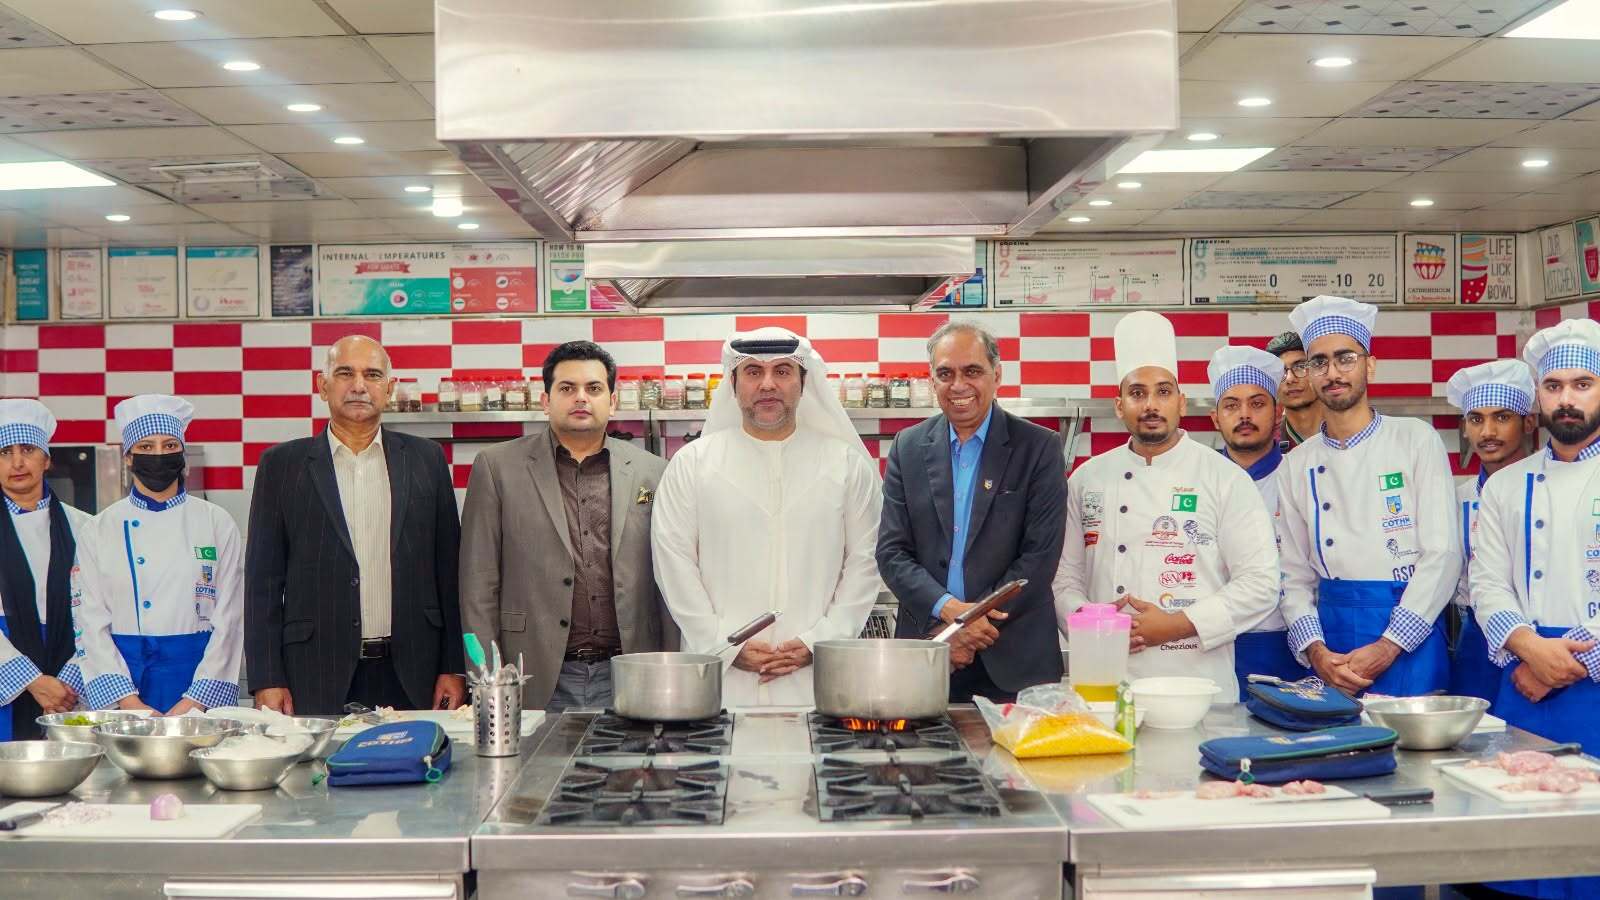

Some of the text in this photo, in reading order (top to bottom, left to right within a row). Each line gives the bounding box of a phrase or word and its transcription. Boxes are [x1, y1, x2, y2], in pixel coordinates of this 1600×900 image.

[1489, 238, 1512, 255] LIFE
[1491, 263, 1511, 276] LICK
[1269, 274, 1278, 287] 0
[1331, 273, 1352, 287] -10
[1368, 273, 1384, 287] 20
[1488, 285, 1513, 300] BOWL
[1160, 643, 1198, 651] Cheezious
